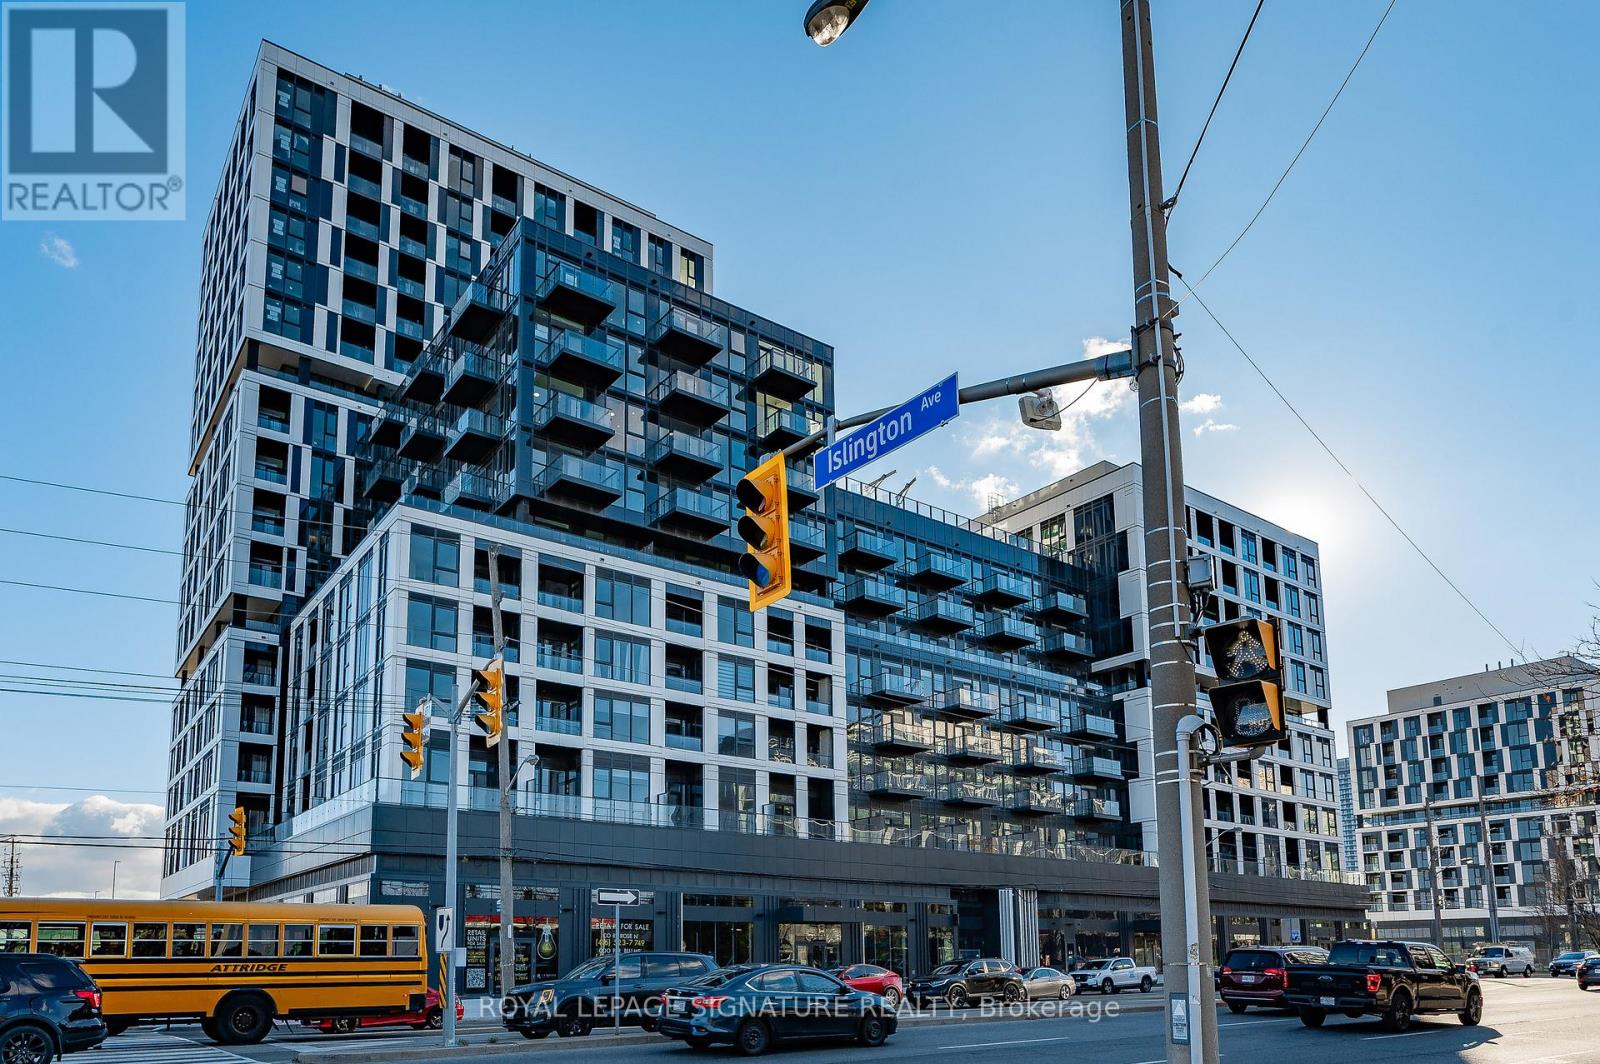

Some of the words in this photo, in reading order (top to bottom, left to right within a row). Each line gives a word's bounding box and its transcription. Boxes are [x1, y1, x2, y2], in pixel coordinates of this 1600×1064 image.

[827, 411, 912, 474] Islington
[921, 390, 942, 412] Ave
[634, 923, 650, 931] SALE
[210, 963, 289, 972] ATTRIDGE
